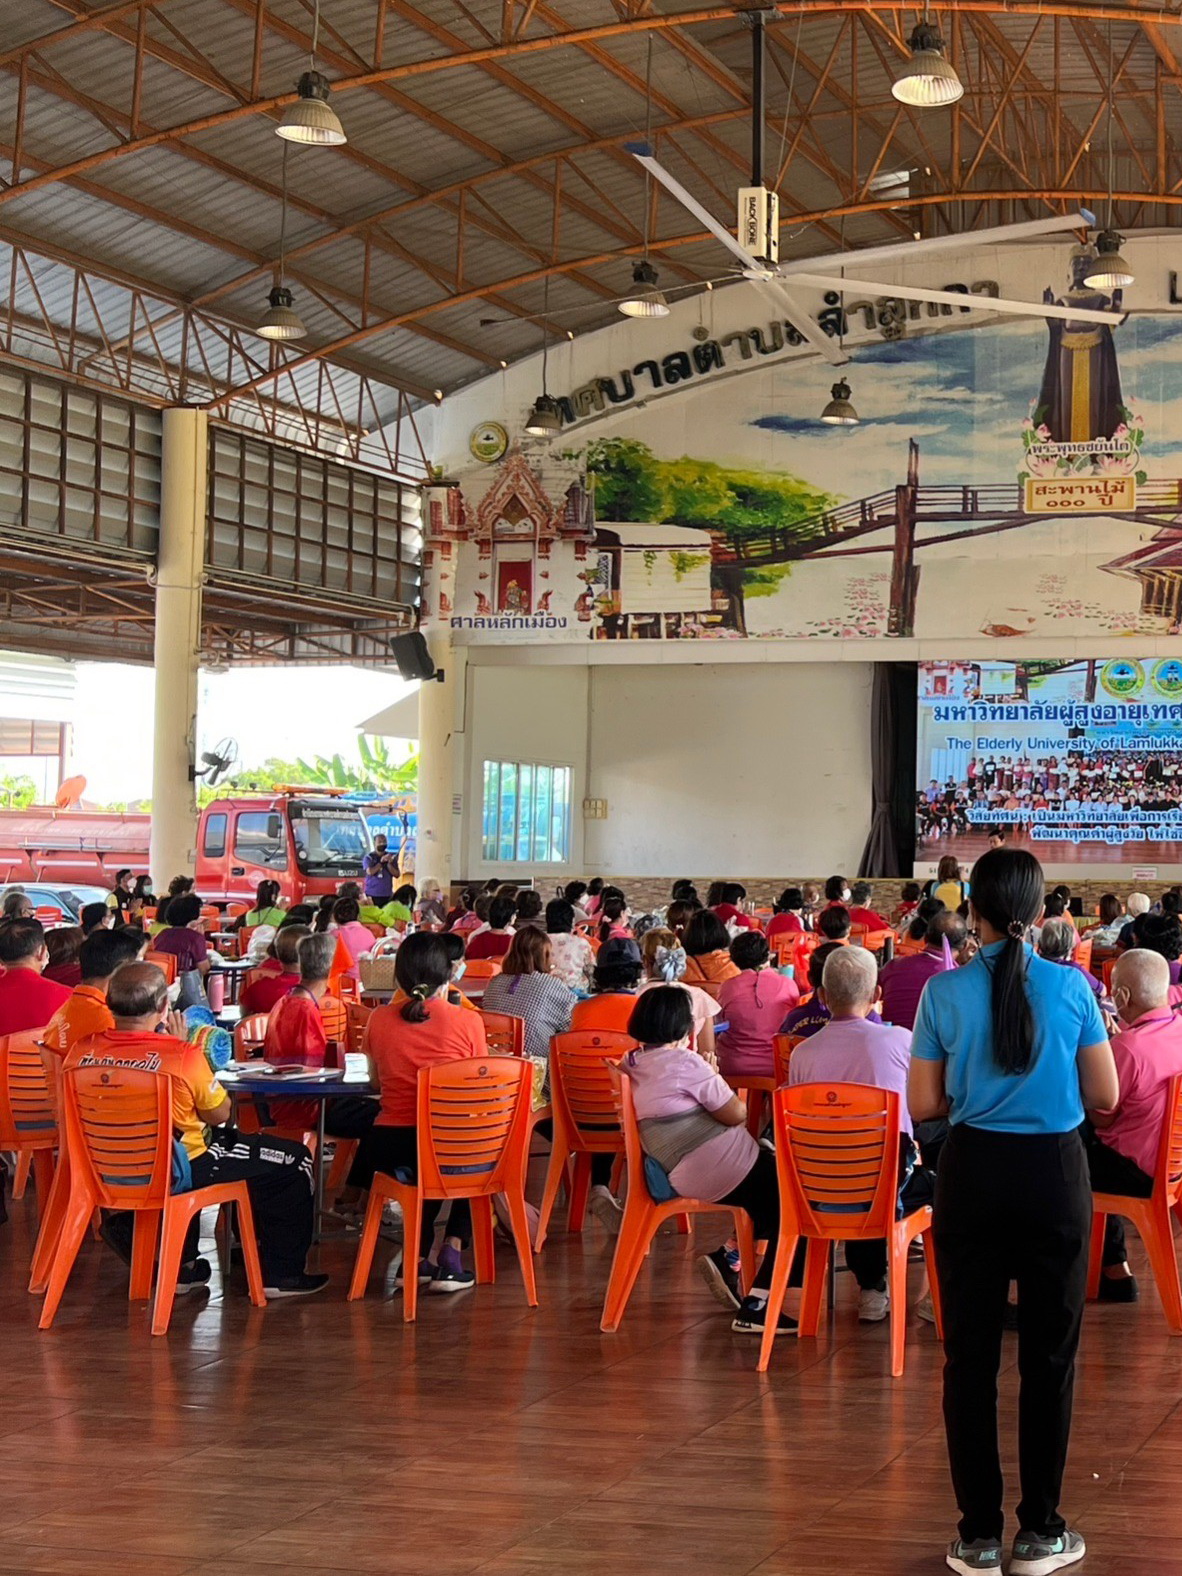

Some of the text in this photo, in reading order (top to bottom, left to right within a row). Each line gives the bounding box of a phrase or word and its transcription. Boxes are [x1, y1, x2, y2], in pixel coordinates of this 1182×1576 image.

[1035, 479, 1126, 496] สะพานไม้
[1097, 493, 1113, 507] ปี
[450, 610, 568, 630] ศาลหลักเมือง
[947, 737, 972, 750] The
[977, 737, 1023, 752] Elderly
[1027, 737, 1096, 752] University
[1101, 737, 1115, 750] of
